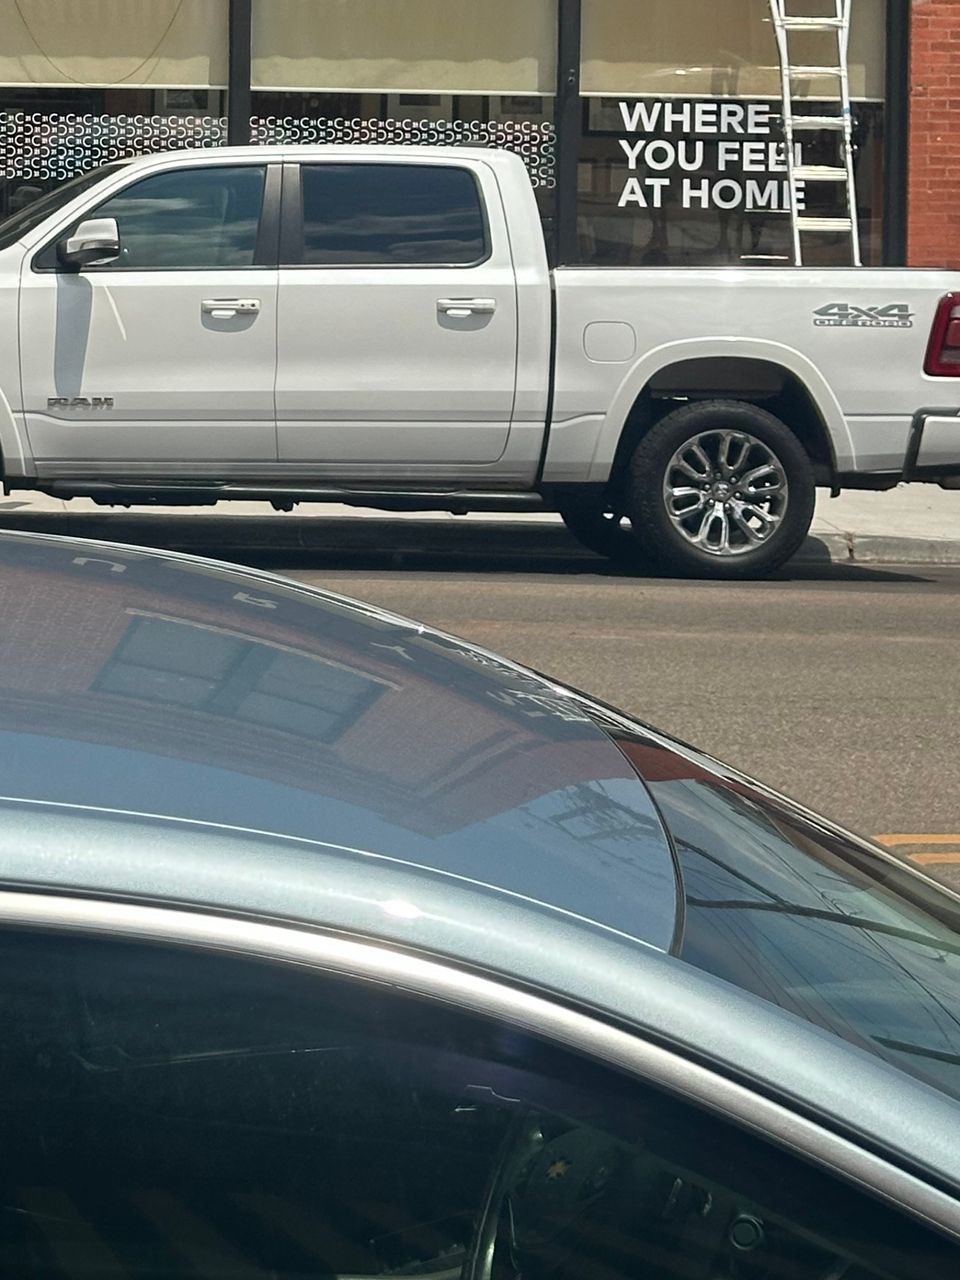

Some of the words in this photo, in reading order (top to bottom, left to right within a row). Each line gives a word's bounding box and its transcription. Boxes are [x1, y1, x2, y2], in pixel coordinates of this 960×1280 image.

[617, 101, 772, 135] WHERE
[617, 139, 705, 172] YOU
[616, 177, 671, 209] AT
[681, 178, 807, 211] HOME
[46, 397, 114, 411] RAM
